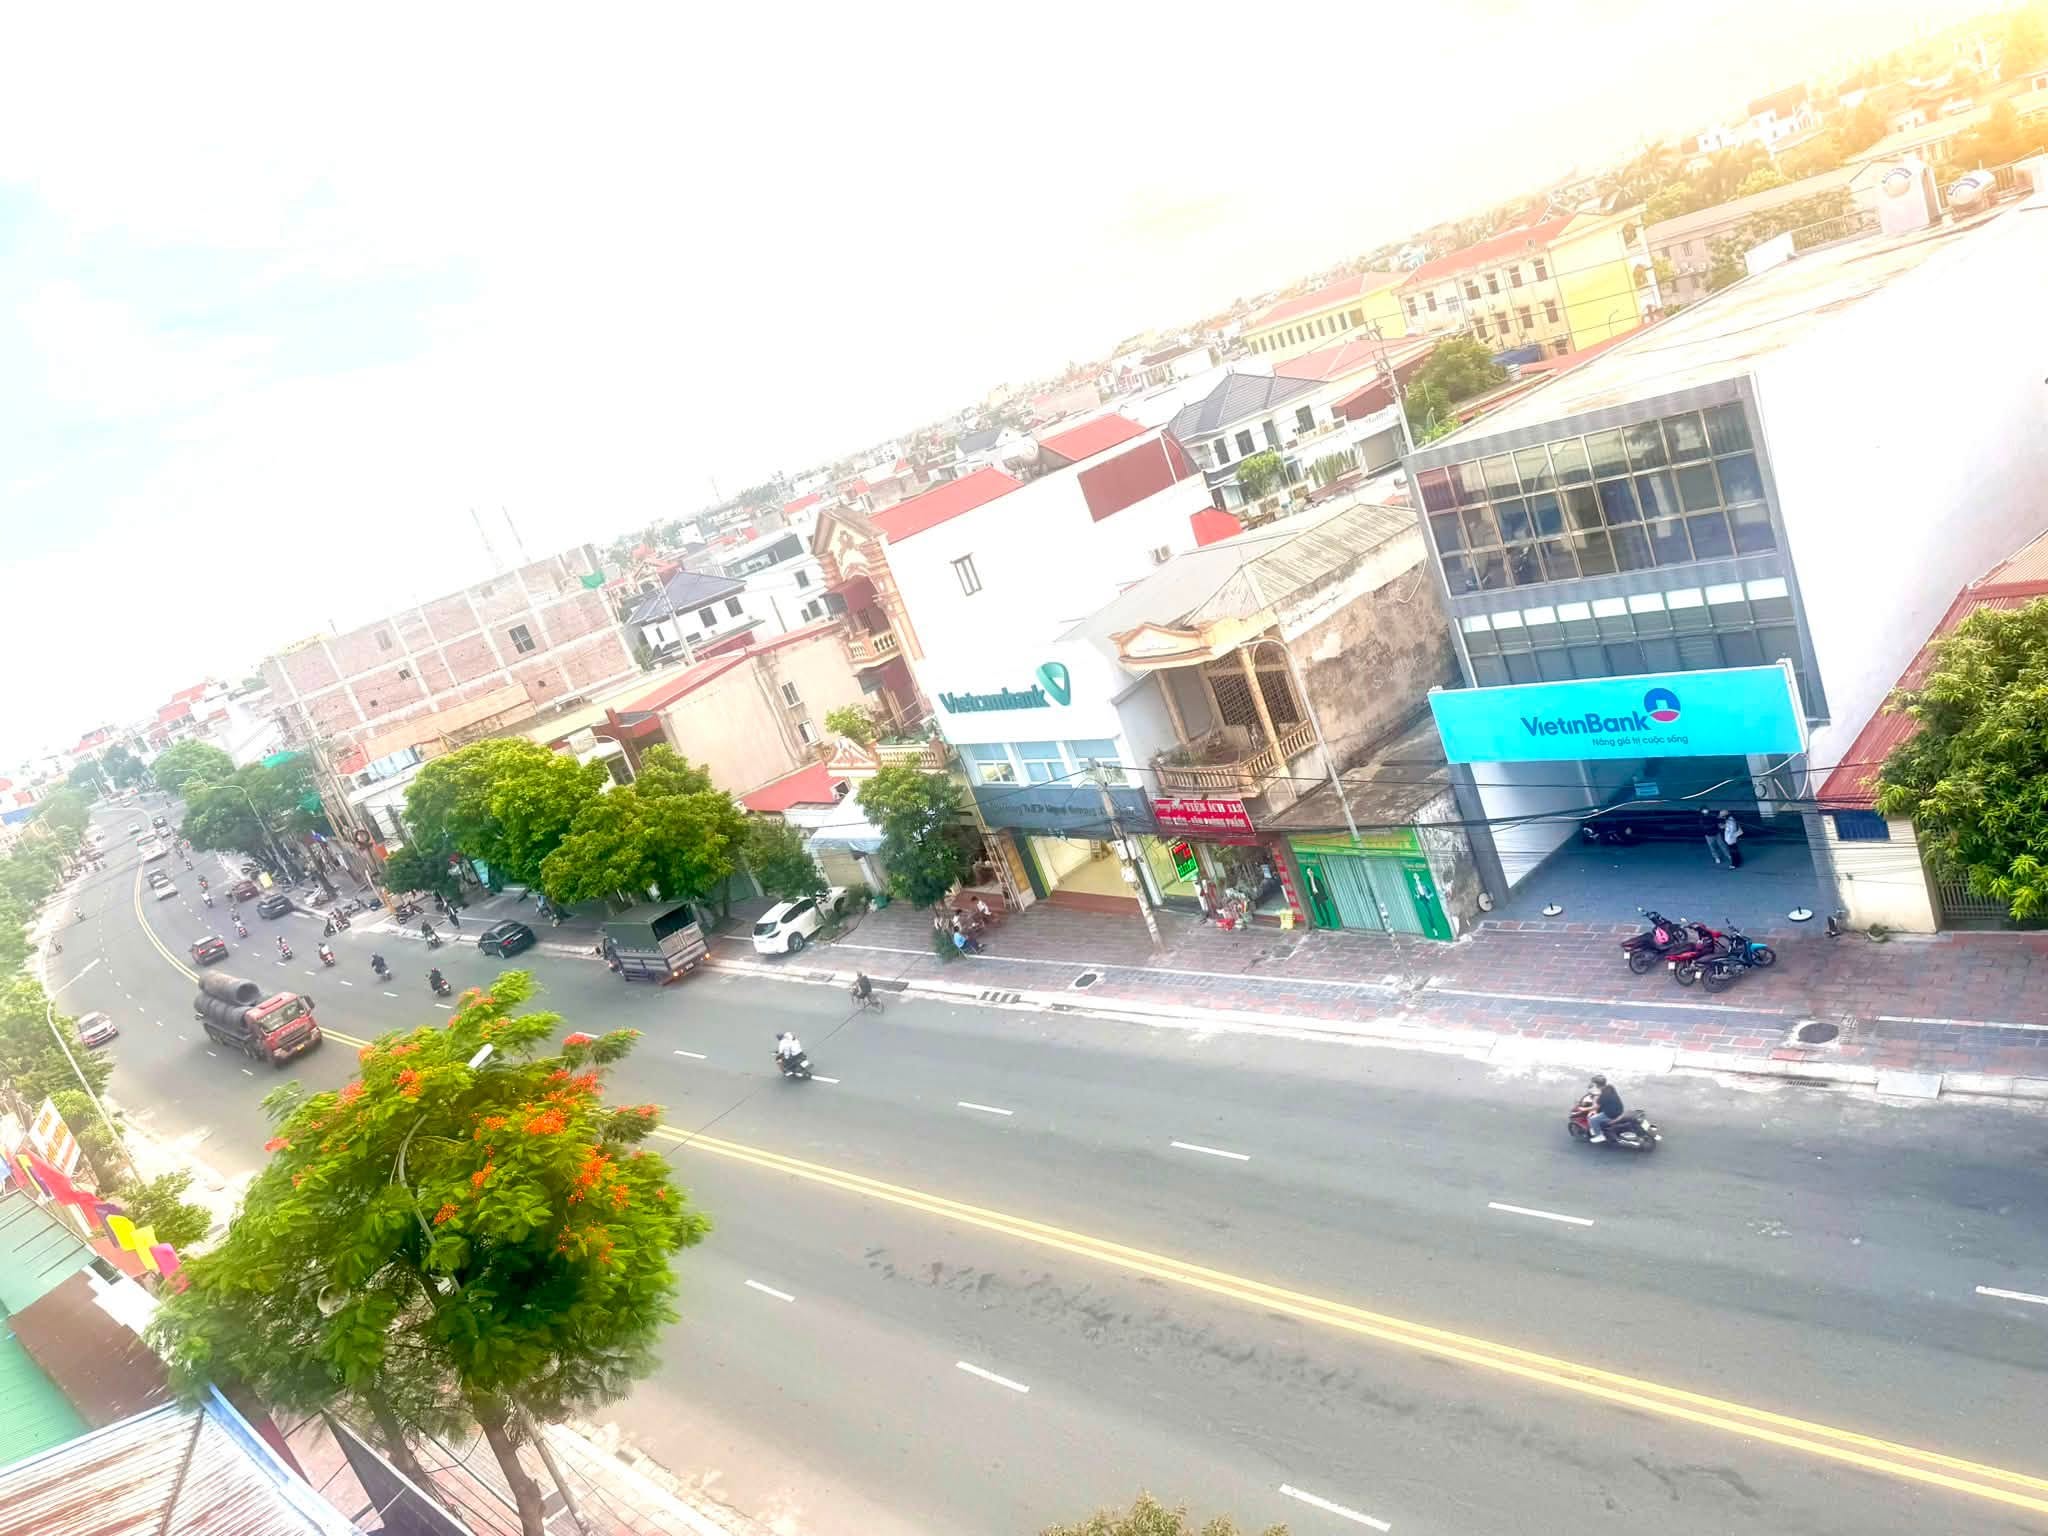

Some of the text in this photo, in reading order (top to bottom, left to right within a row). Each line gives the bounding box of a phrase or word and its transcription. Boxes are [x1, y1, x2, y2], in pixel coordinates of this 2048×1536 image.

[938, 684, 1051, 714] Vietcombank
[1520, 711, 1652, 737] VietinBank
[1617, 736, 1631, 746] giá
[1642, 735, 1665, 744] cuộc
[1666, 734, 1689, 745] sống
